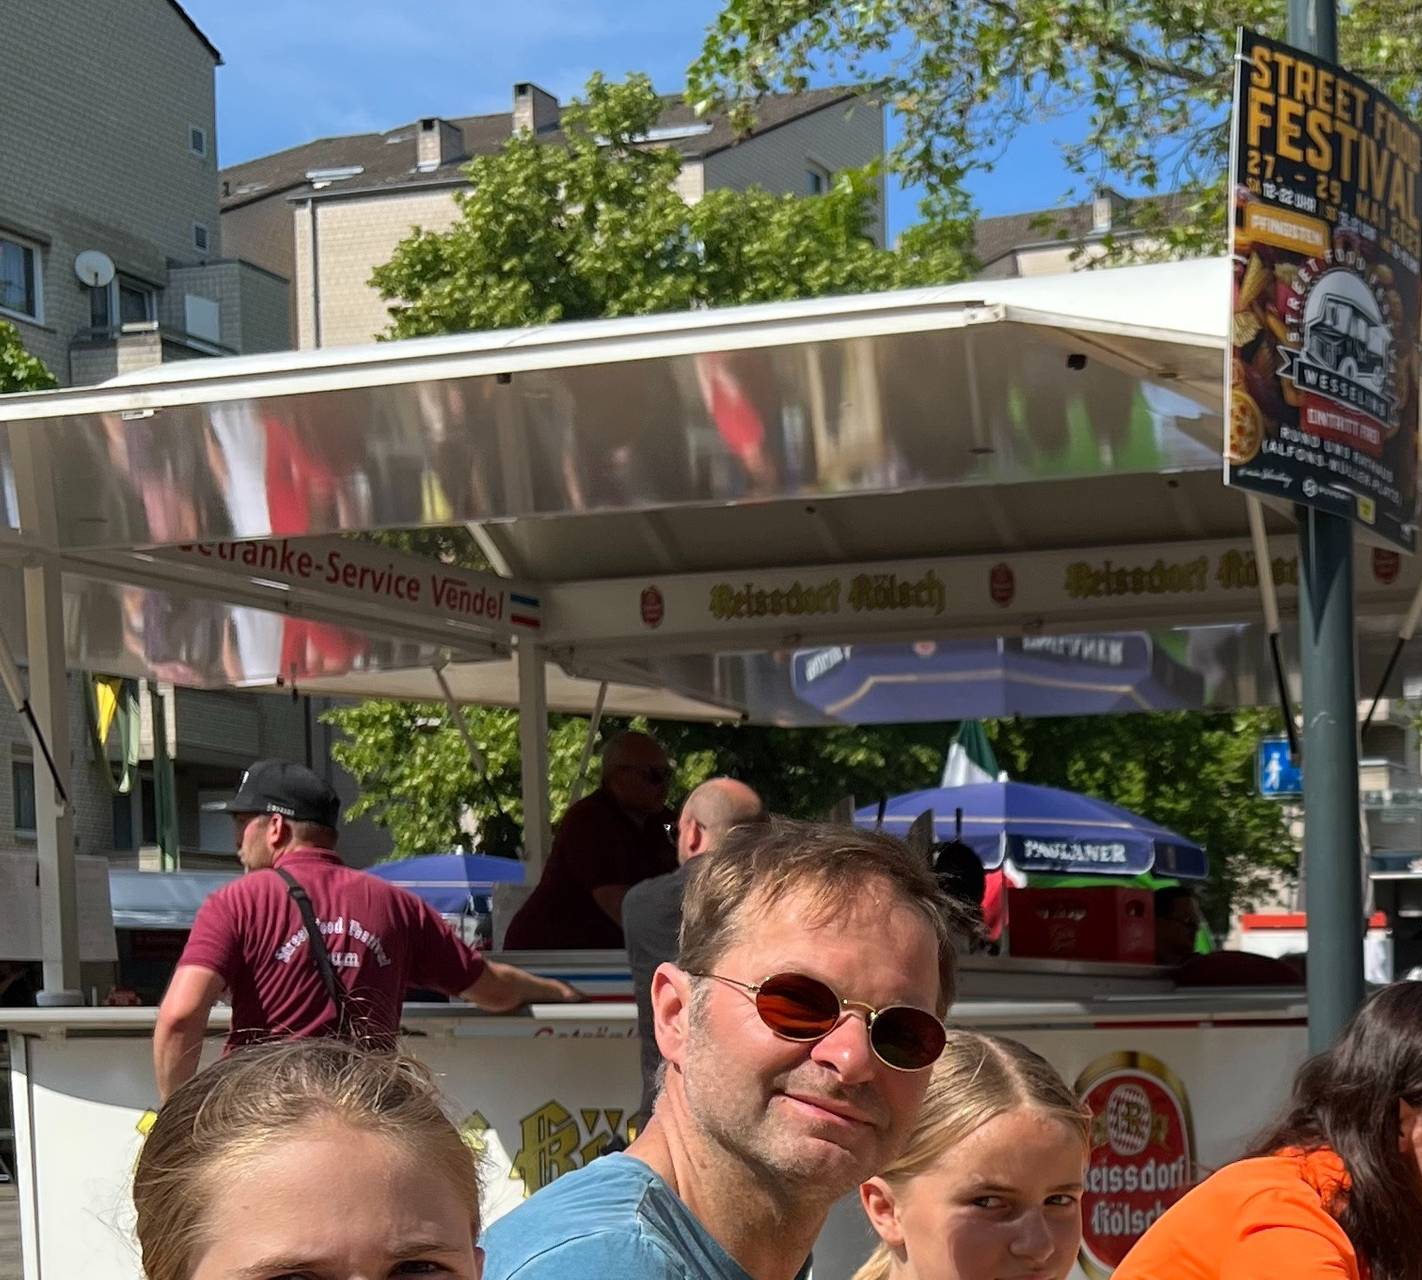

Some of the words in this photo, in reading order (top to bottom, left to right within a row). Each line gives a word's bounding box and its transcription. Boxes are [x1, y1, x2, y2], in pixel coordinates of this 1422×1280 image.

[1250, 45, 1370, 131] STREET
[1373, 101, 1421, 174] FOOD
[1246, 151, 1284, 182] 27.
[1315, 174, 1348, 208] 29.
[1247, 86, 1421, 232] FESTIVAL
[1302, 367, 1388, 418] WESSELING
[431, 573, 506, 621] Vendel
[1023, 839, 1128, 863] PAULANER
